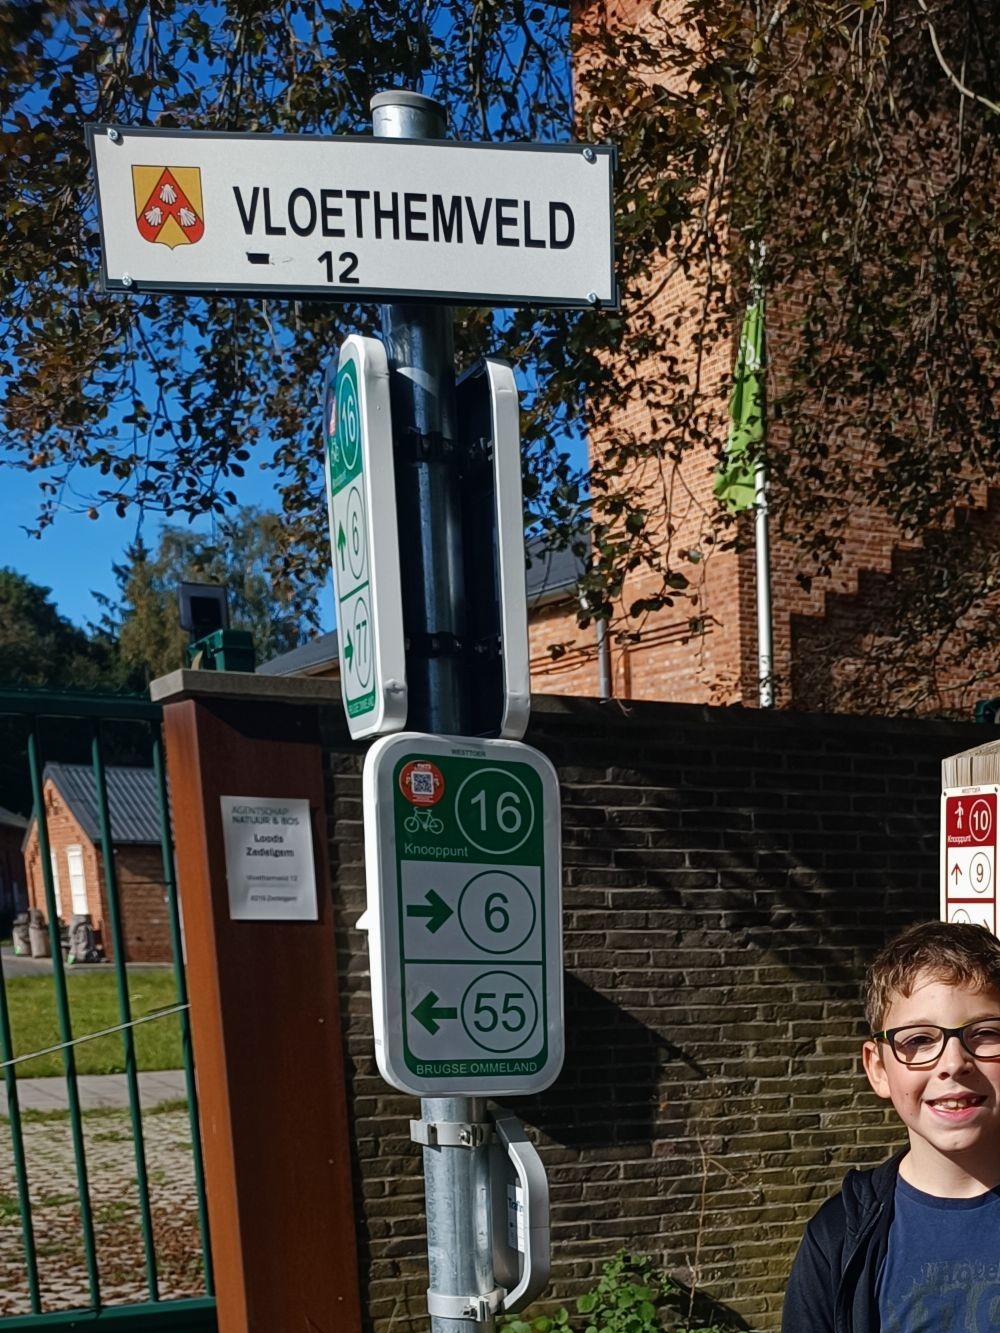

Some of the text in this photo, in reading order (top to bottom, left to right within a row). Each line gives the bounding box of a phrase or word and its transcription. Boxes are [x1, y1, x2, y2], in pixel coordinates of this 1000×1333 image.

[232, 186, 576, 250] VLOETHEMVELD
[317, 250, 360, 285] 12
[342, 395, 356, 448] 16
[351, 511, 360, 556] 6
[355, 619, 367, 667] 77
[470, 789, 522, 834] 16
[973, 810, 989, 831] 10
[245, 846, 295, 858] Zedelgem
[254, 833, 284, 843] Loods
[403, 842, 469, 859] Knooppunt
[976, 863, 984, 883] 9
[484, 892, 510, 934] 6
[473, 992, 527, 1033] 55
[416, 1062, 538, 1076] BRUGSE OMMELAND
